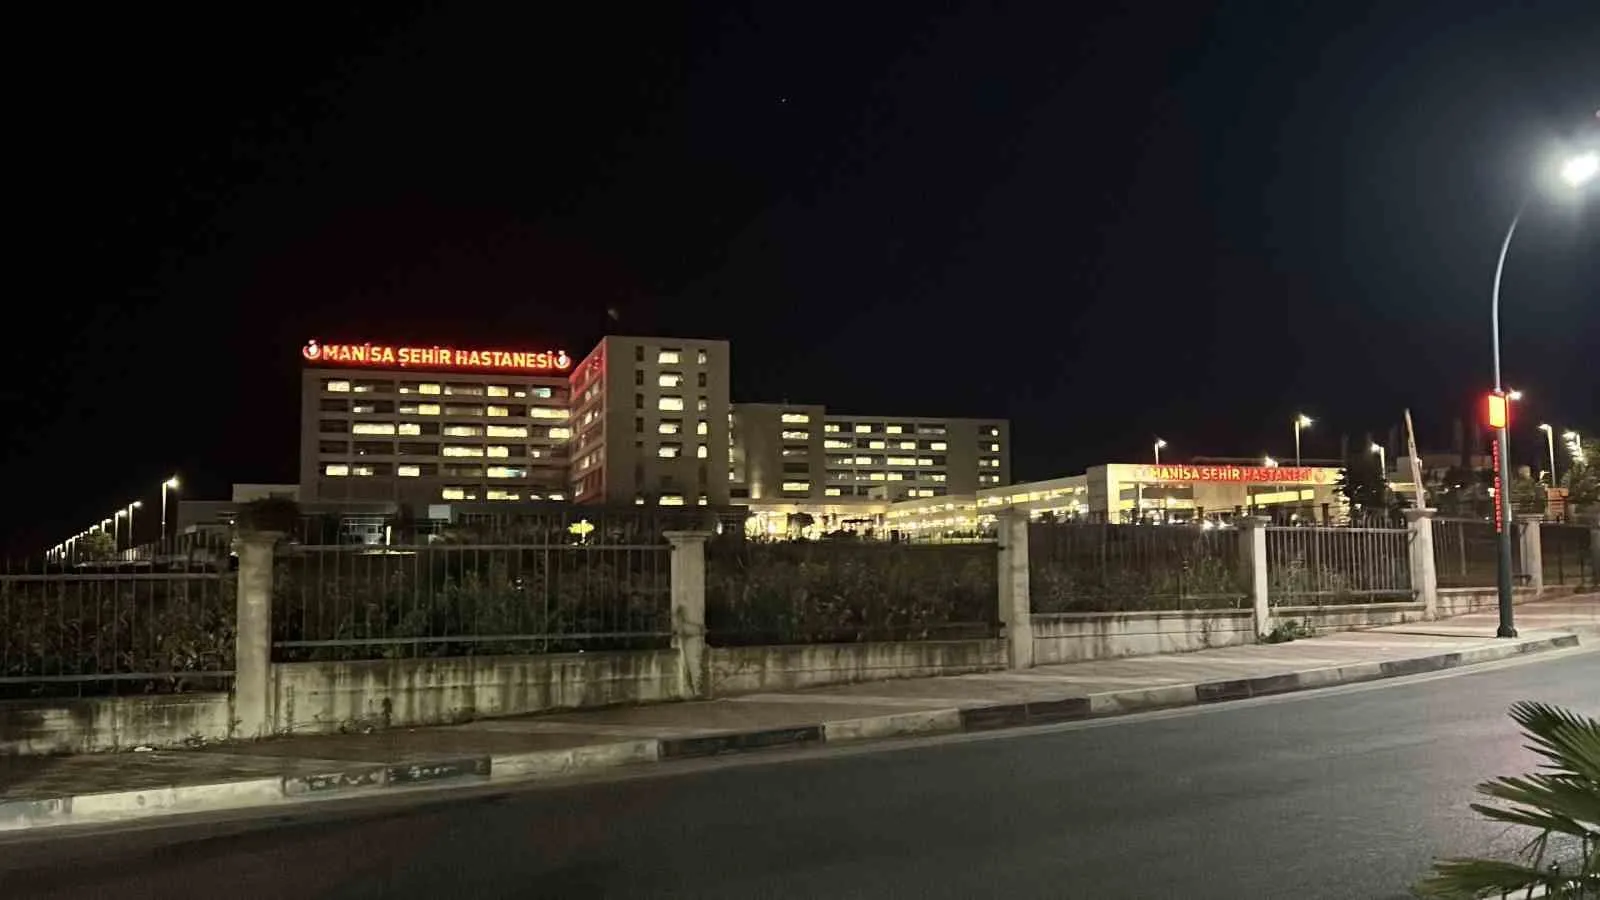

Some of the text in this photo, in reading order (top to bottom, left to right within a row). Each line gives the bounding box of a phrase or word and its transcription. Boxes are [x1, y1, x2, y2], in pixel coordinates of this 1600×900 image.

[322, 342, 553, 368] MANİSA ŞEHİR HASTANESİ
